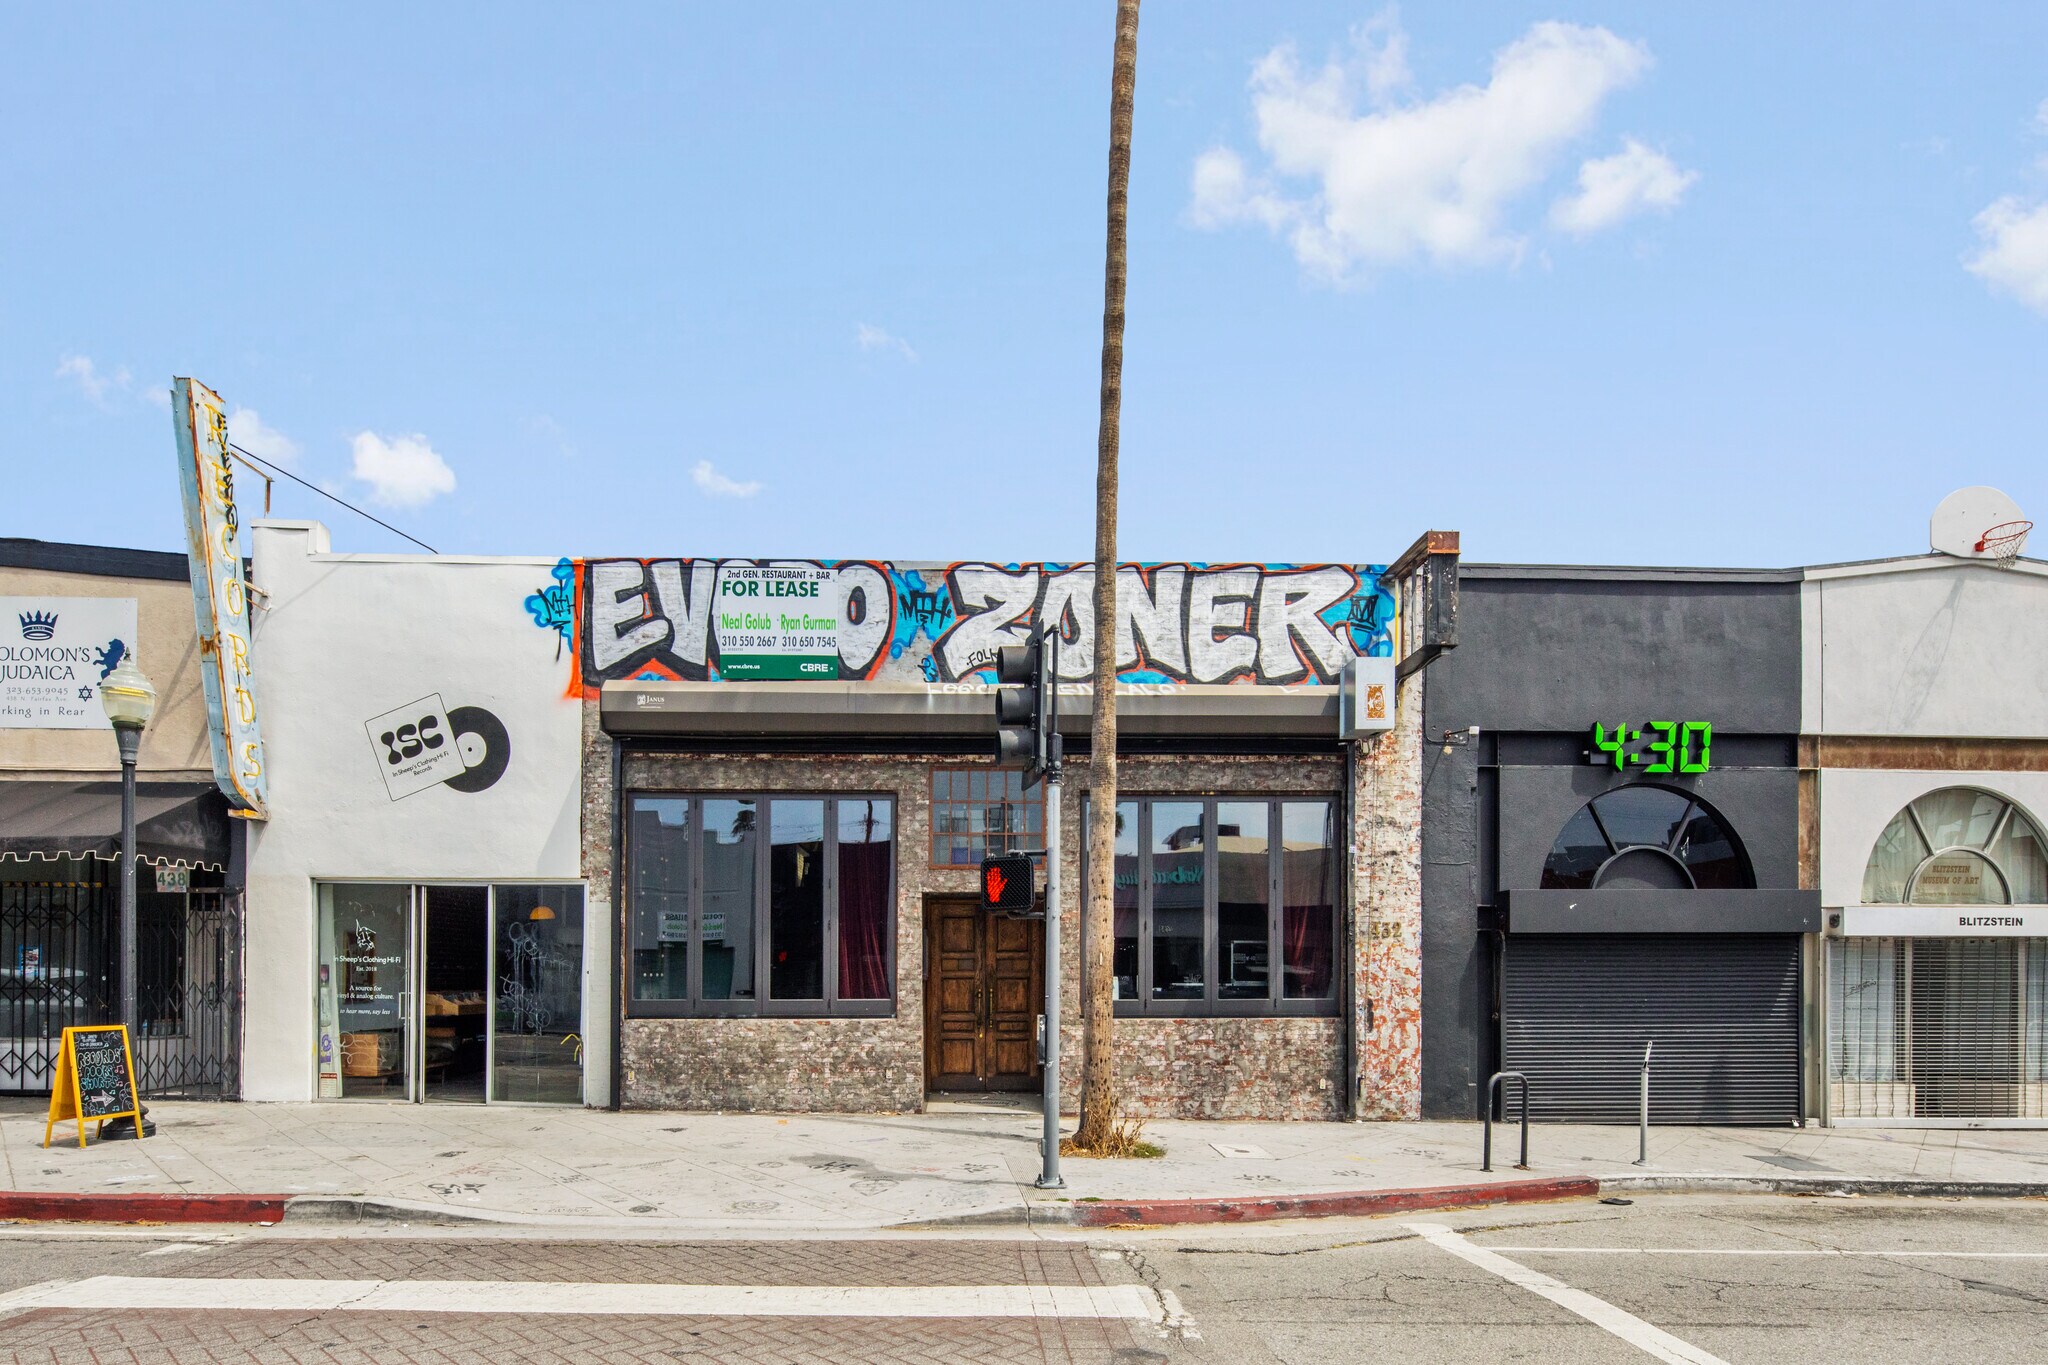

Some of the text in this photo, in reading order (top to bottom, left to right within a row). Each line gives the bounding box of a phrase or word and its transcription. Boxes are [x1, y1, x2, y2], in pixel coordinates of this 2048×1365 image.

[727, 569, 740, 579] 2nd
[742, 570, 760, 579] GEN.
[761, 570, 807, 579] RESTAURANT
[816, 571, 831, 580] BAR
[203, 402, 264, 784] RECORDS
[722, 581, 819, 597] FOR LEASE
[721, 613, 771, 630] Neal Golub
[780, 614, 837, 635] Ryan Gurman
[721, 636, 777, 647] 310 550 2667
[782, 636, 837, 648] 310 650 7545
[800, 663, 829, 672] CBRE
[0, 665, 75, 684] JUDAICA
[40, 706, 50, 716] in
[58, 706, 85, 716] Rear
[1595, 721, 1712, 773] 4:30
[398, 765, 417, 776] Sheep's
[417, 756, 438, 768] Clothing
[413, 765, 432, 776] Records
[1932, 865, 1971, 874] BLITZSTEIN
[157, 872, 186, 887] 438
[1922, 876, 1980, 885] MUSEUM OF ART
[1959, 917, 2023, 927] BLITZSTEIN
[340, 955, 362, 964] Sheep's
[363, 956, 386, 965] Clothing
